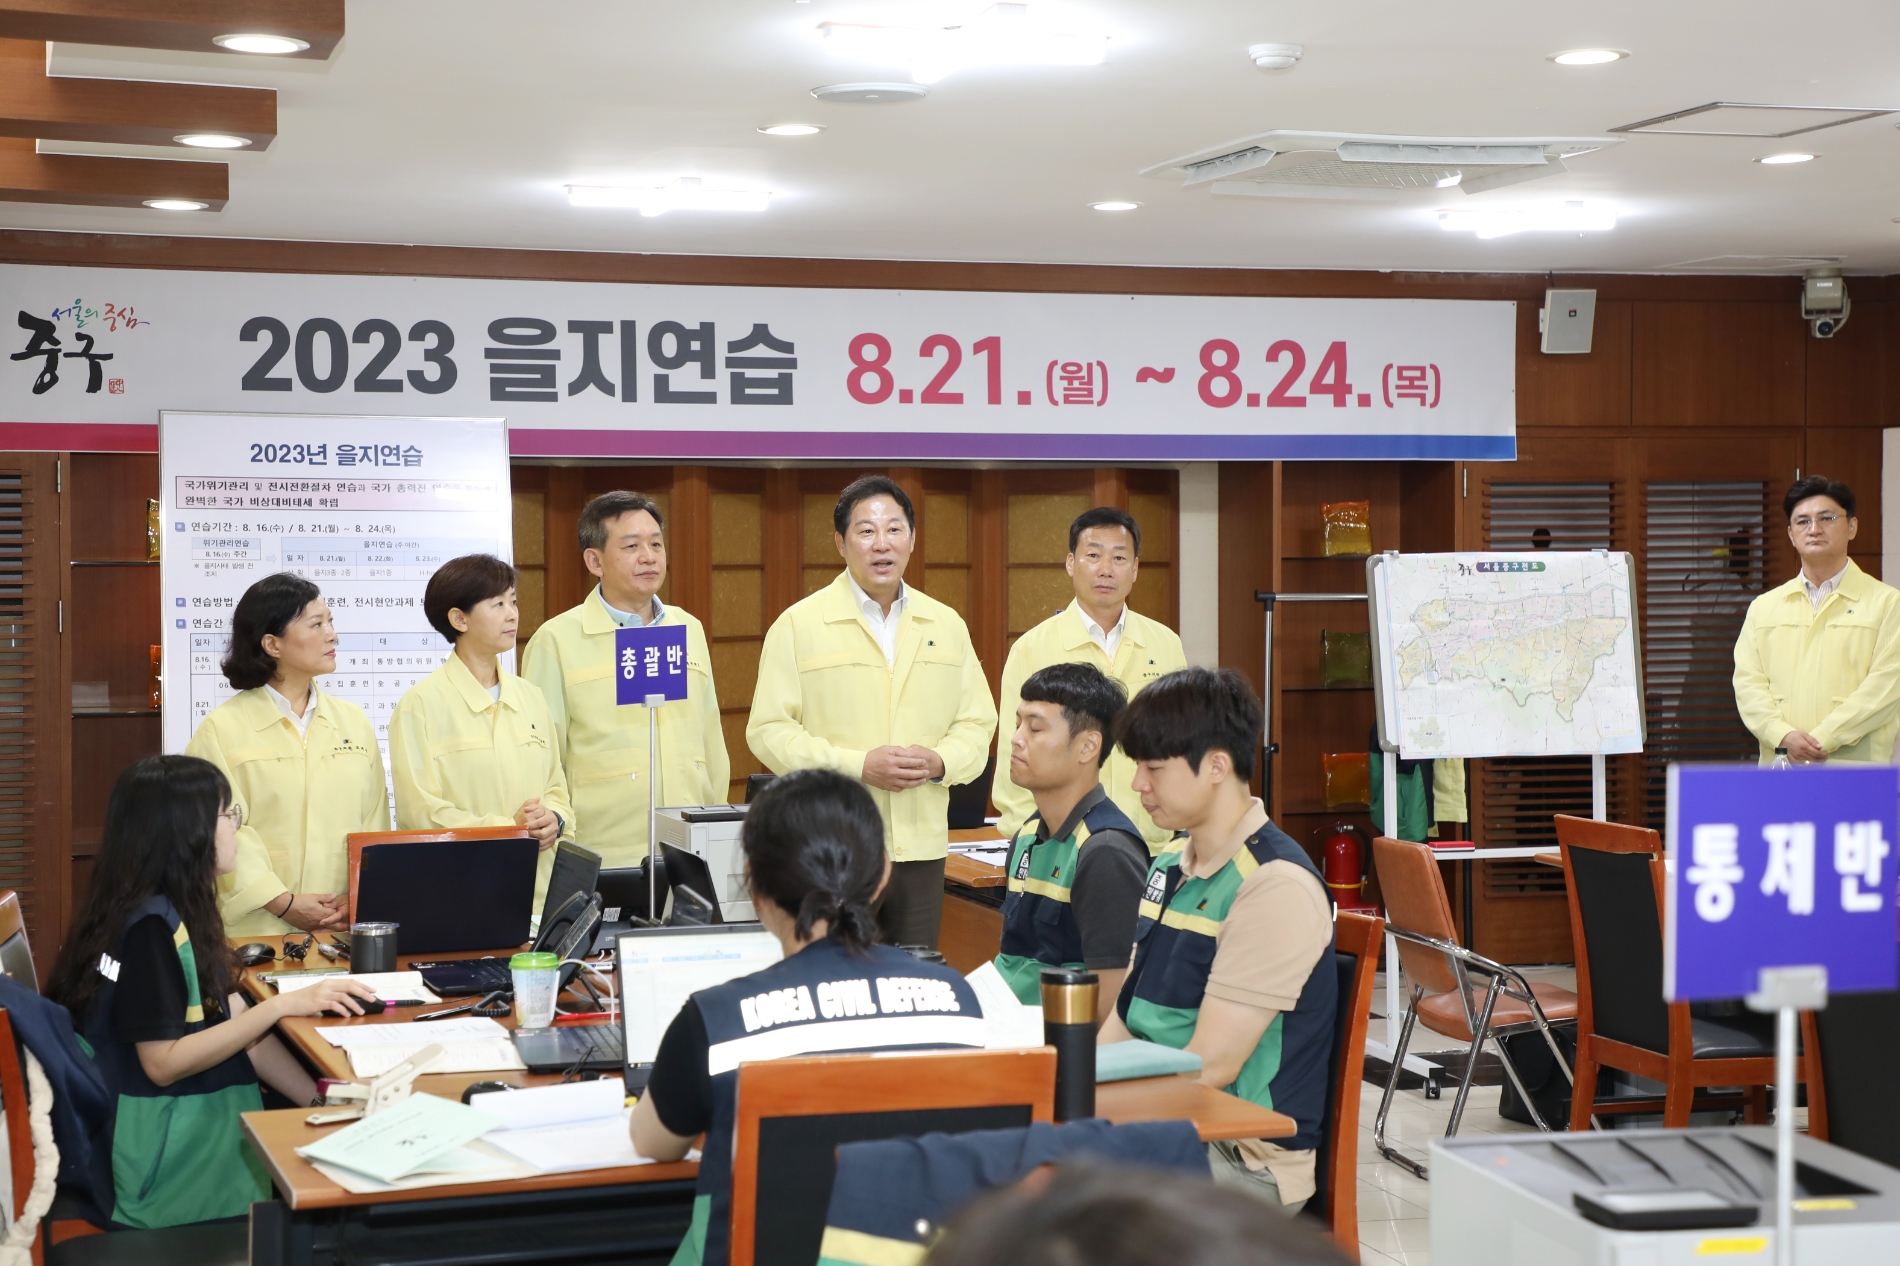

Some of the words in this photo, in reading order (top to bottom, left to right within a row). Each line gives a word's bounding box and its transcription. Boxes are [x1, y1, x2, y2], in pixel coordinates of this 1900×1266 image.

[10, 310, 114, 394] 중구
[240, 316, 457, 394] 2023
[484, 317, 797, 405] 을지연습
[251, 444, 327, 465] 2023년
[336, 445, 423, 466] 을지연습
[184, 480, 249, 491] 국가위기관리
[370, 483, 391, 493] 국가
[184, 495, 218, 507] 완벽한
[222, 496, 244, 507] 국가
[191, 521, 233, 533] 연습기간
[192, 597, 233, 608] 연습방법
[192, 618, 224, 629] 연습간
[1686, 820, 1890, 922] 통제반
[740, 986, 816, 1032] KOREA
[817, 979, 877, 1019] CIVIL
